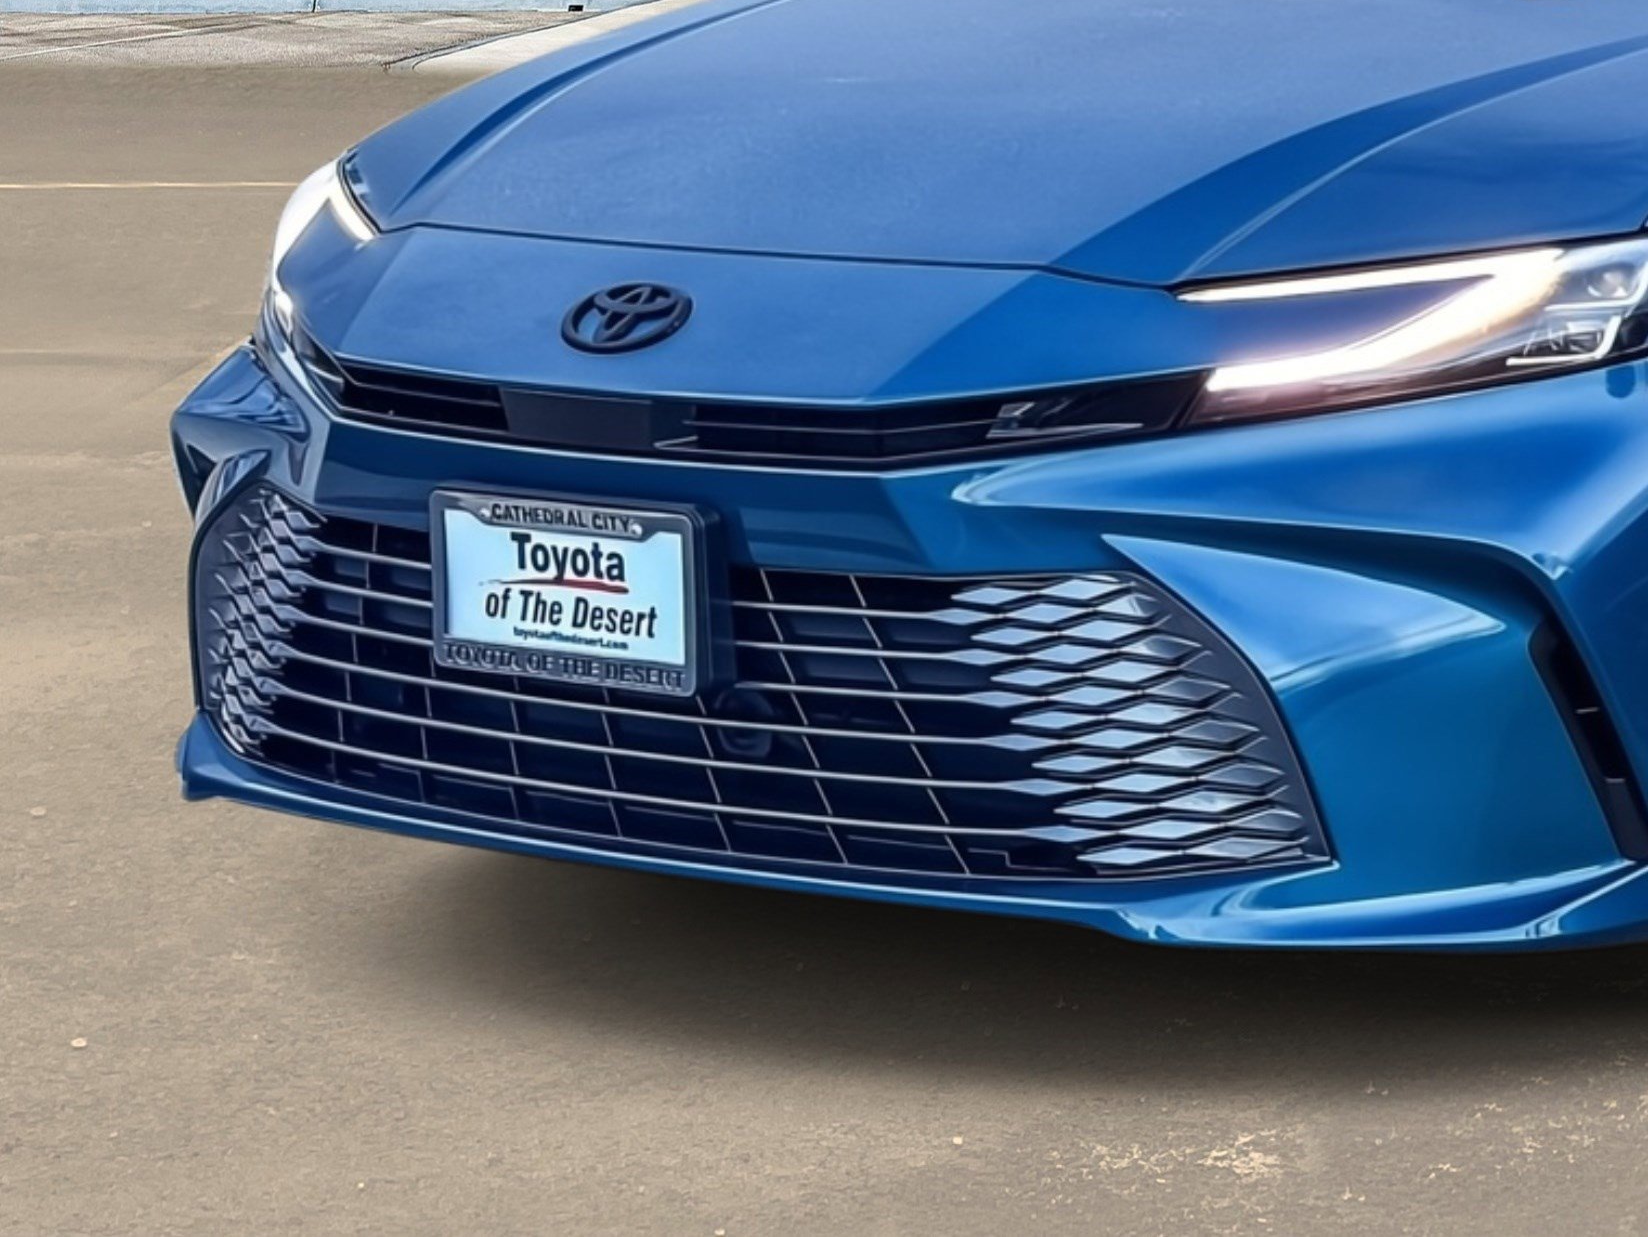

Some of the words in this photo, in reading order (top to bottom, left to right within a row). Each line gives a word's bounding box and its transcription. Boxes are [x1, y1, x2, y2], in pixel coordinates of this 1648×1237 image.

[491, 503, 588, 529] CATHEDRAL
[592, 514, 630, 533] CITY
[510, 531, 626, 582] Toyota
[485, 587, 512, 619] of
[518, 589, 563, 626] The
[571, 595, 658, 639] Desert
[526, 653, 553, 674] OF
[559, 657, 600, 678] THE
[604, 663, 686, 690] DESERT
